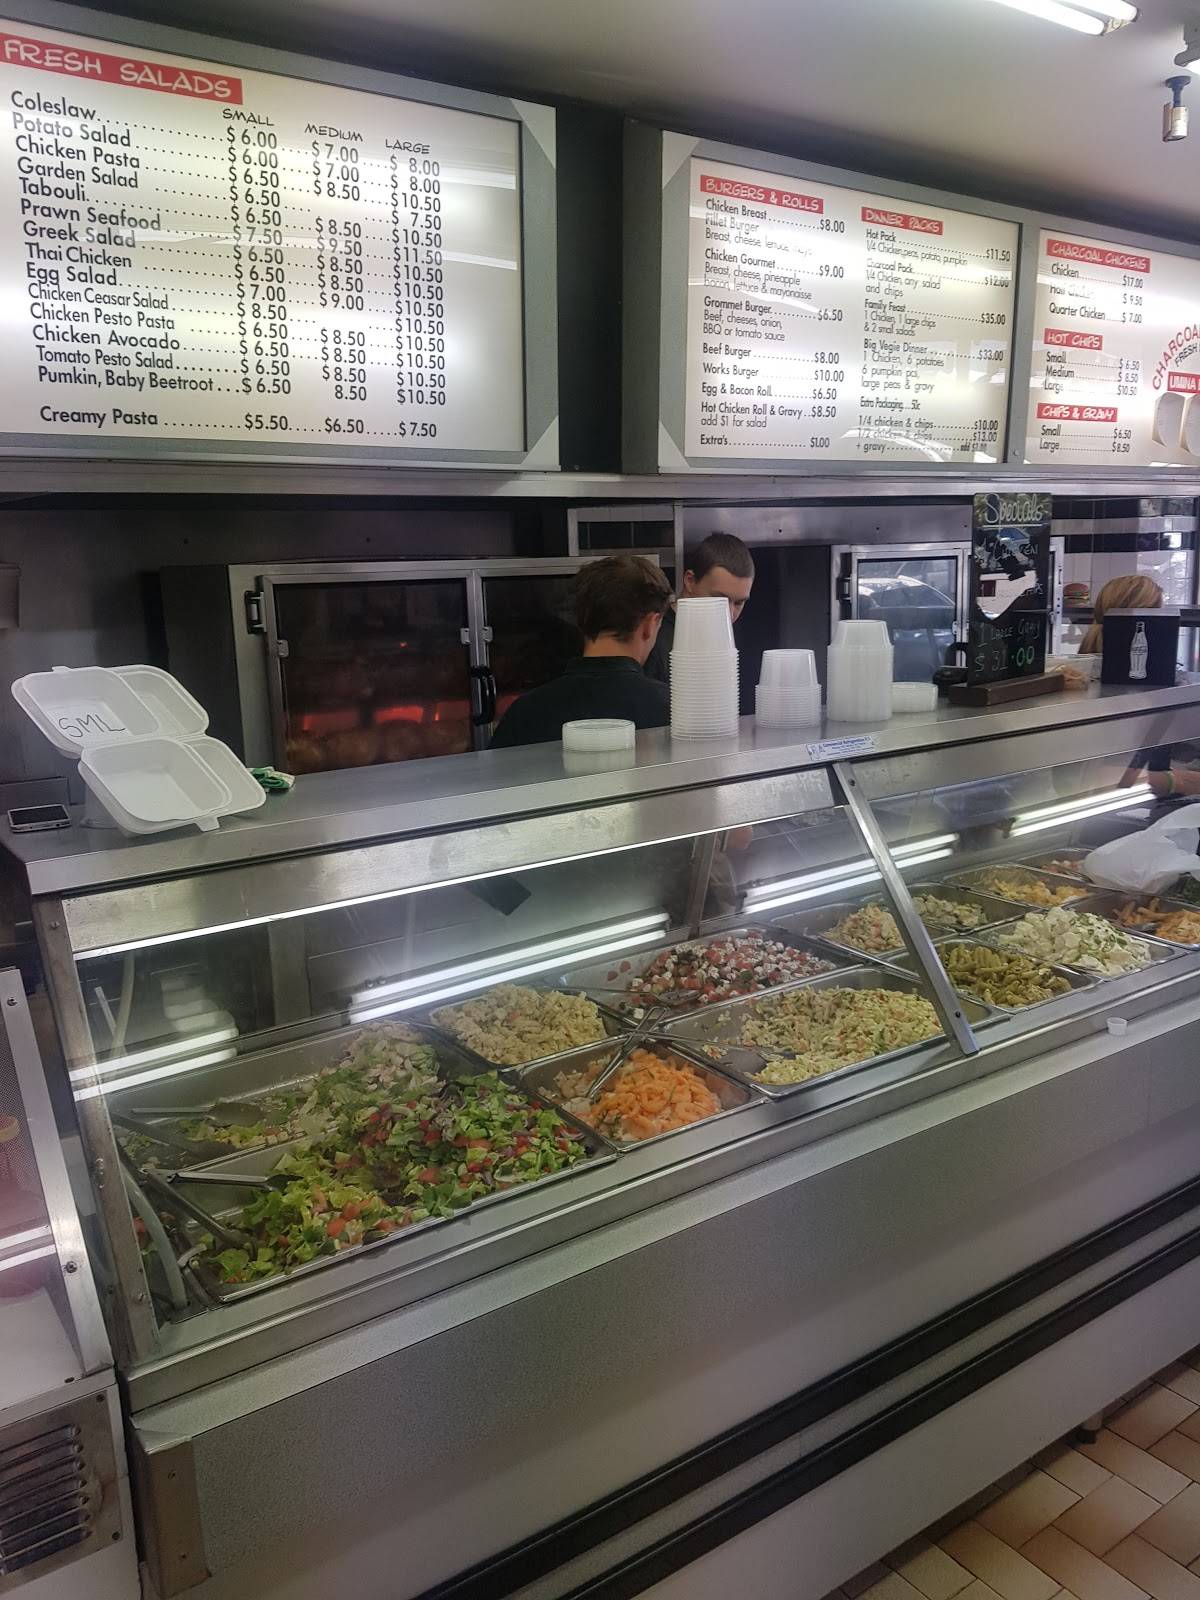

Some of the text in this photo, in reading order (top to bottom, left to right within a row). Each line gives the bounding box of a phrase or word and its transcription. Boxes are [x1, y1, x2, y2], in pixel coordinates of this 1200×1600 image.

[4, 40, 231, 98] FRESH SALADS
[11, 91, 97, 120] Coleslaw
[12, 112, 131, 147] Potato Salad
[222, 108, 432, 154] SMALL MEDIUM LARGE
[15, 135, 441, 213] Chicken Pasta $10.50
[17, 156, 138, 188] Garden Salad
[705, 179, 819, 211] BURGERS & ROLLS
[19, 177, 442, 248] Tabouli $10.50
[705, 198, 845, 233] Chicken Breast $8.00
[866, 210, 940, 233] DINNER PACKS
[21, 199, 442, 266] Prawn Seafood $11.50
[730, 217, 759, 235] Burger
[23, 220, 443, 284] Greek Salad $10.50
[866, 229, 1011, 262] Hot Pack $11.50
[1052, 243, 1147, 269] CHARCOAL CHICKENS
[25, 242, 443, 301] Thai Chicken $10.50
[705, 248, 844, 279] Chicken Gourmet $9.00
[1051, 262, 1079, 278] Chicken
[26, 262, 444, 319] Egg Salad $10.50
[764, 271, 801, 290] pineapple
[28, 282, 444, 336] Chicken Ceasar Salad $10.50
[817, 309, 843, 322] $6.50
[865, 298, 1006, 325] Family Feast $35.00
[1049, 302, 1105, 321] Quarter Chicken
[30, 302, 444, 353] Chicken Pesto Pasta $10.50
[703, 323, 785, 342] BBQ or tomato sauce
[1047, 333, 1100, 348] HOT CHIPS
[32, 323, 445, 370] Chicken Avocado $10.50
[703, 343, 840, 365] Beef Burger $8.00
[864, 338, 876, 350] Big
[903, 342, 927, 353] Dinner
[1046, 351, 1067, 363] Small
[35, 345, 445, 388] Tomato Pesto Salad $10.50
[703, 362, 844, 382] Works Burger $10.00
[1045, 365, 1075, 378] Medium
[38, 365, 446, 406] Pumkin, Baby Beetroot 8.50 $10.50
[702, 382, 717, 397] Egg
[730, 384, 754, 396] Bacon
[812, 388, 837, 400] $6.50
[40, 406, 106, 428] Creamy
[112, 409, 158, 425] Pasta
[244, 412, 289, 431] $5.50
[324, 417, 364, 434] $6.50
[701, 402, 837, 420] Hot Chicken Roll Gravy $8.50
[701, 414, 767, 428] add for salad
[874, 416, 903, 427] chicken
[974, 420, 998, 430] $10.00
[1042, 406, 1114, 420] CHIPS & GRAVY
[700, 434, 728, 446] Extra's
[973, 431, 997, 442] $13.00
[1041, 424, 1062, 436] Small
[1040, 438, 1060, 452] Large
[984, 492, 1043, 524] Specials
[58, 714, 127, 738] SML
